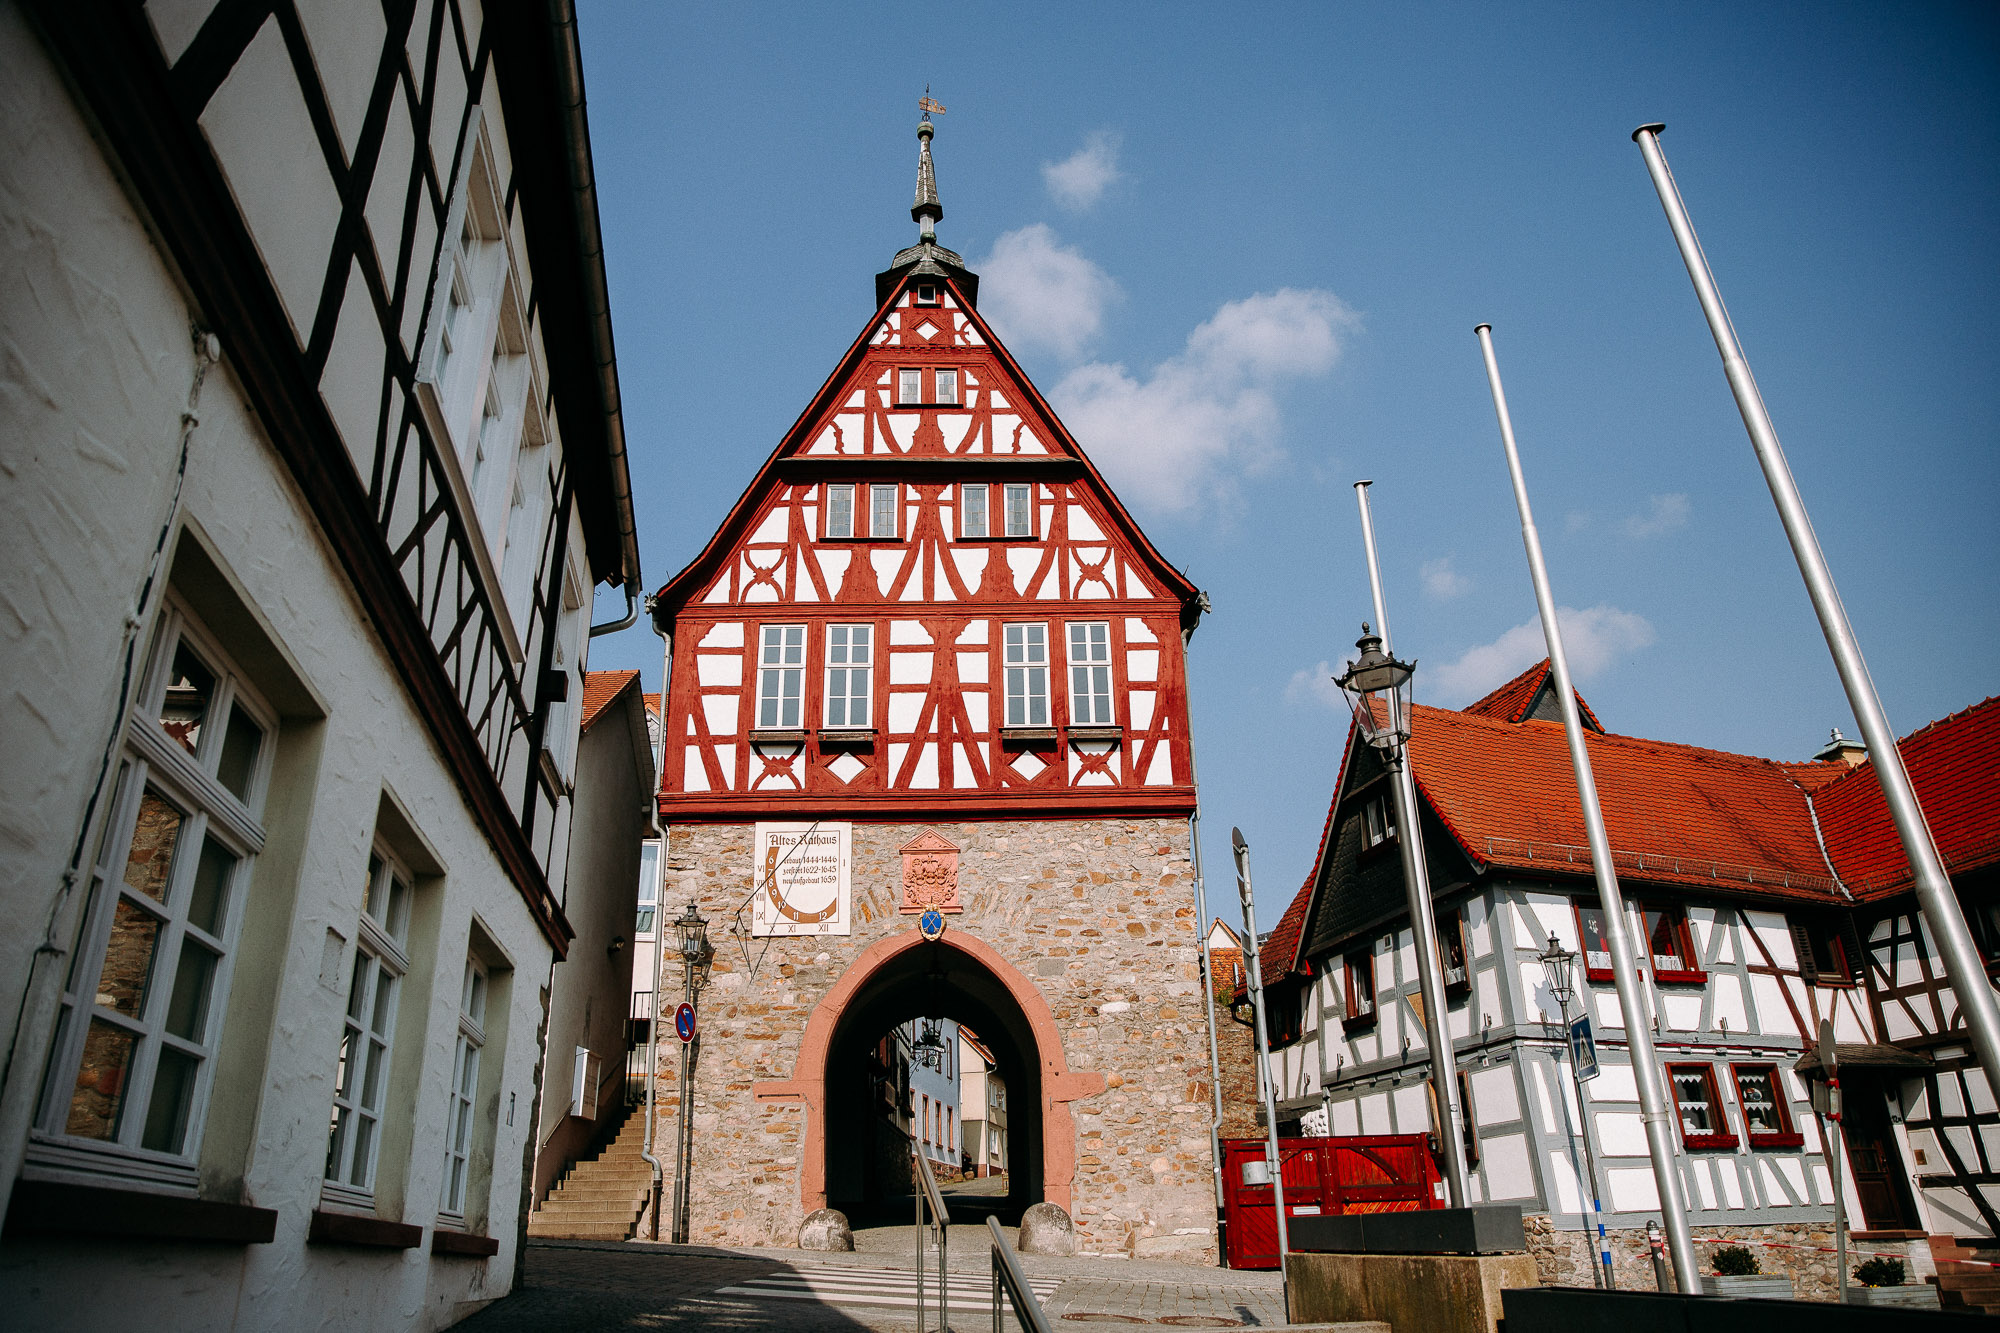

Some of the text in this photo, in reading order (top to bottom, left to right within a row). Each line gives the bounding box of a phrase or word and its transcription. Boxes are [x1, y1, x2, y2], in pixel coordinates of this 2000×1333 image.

[770, 834, 837, 846] Altes Rathaus
[768, 855, 774, 864] 6
[768, 868, 773, 877] 7
[768, 878, 774, 888] 8
[772, 888, 777, 898] 9
[756, 912, 764, 920] IX
[793, 912, 799, 920] 11
[819, 912, 827, 920] 12
[788, 925, 796, 933] XI
[1304, 1153, 1313, 1161] 13
